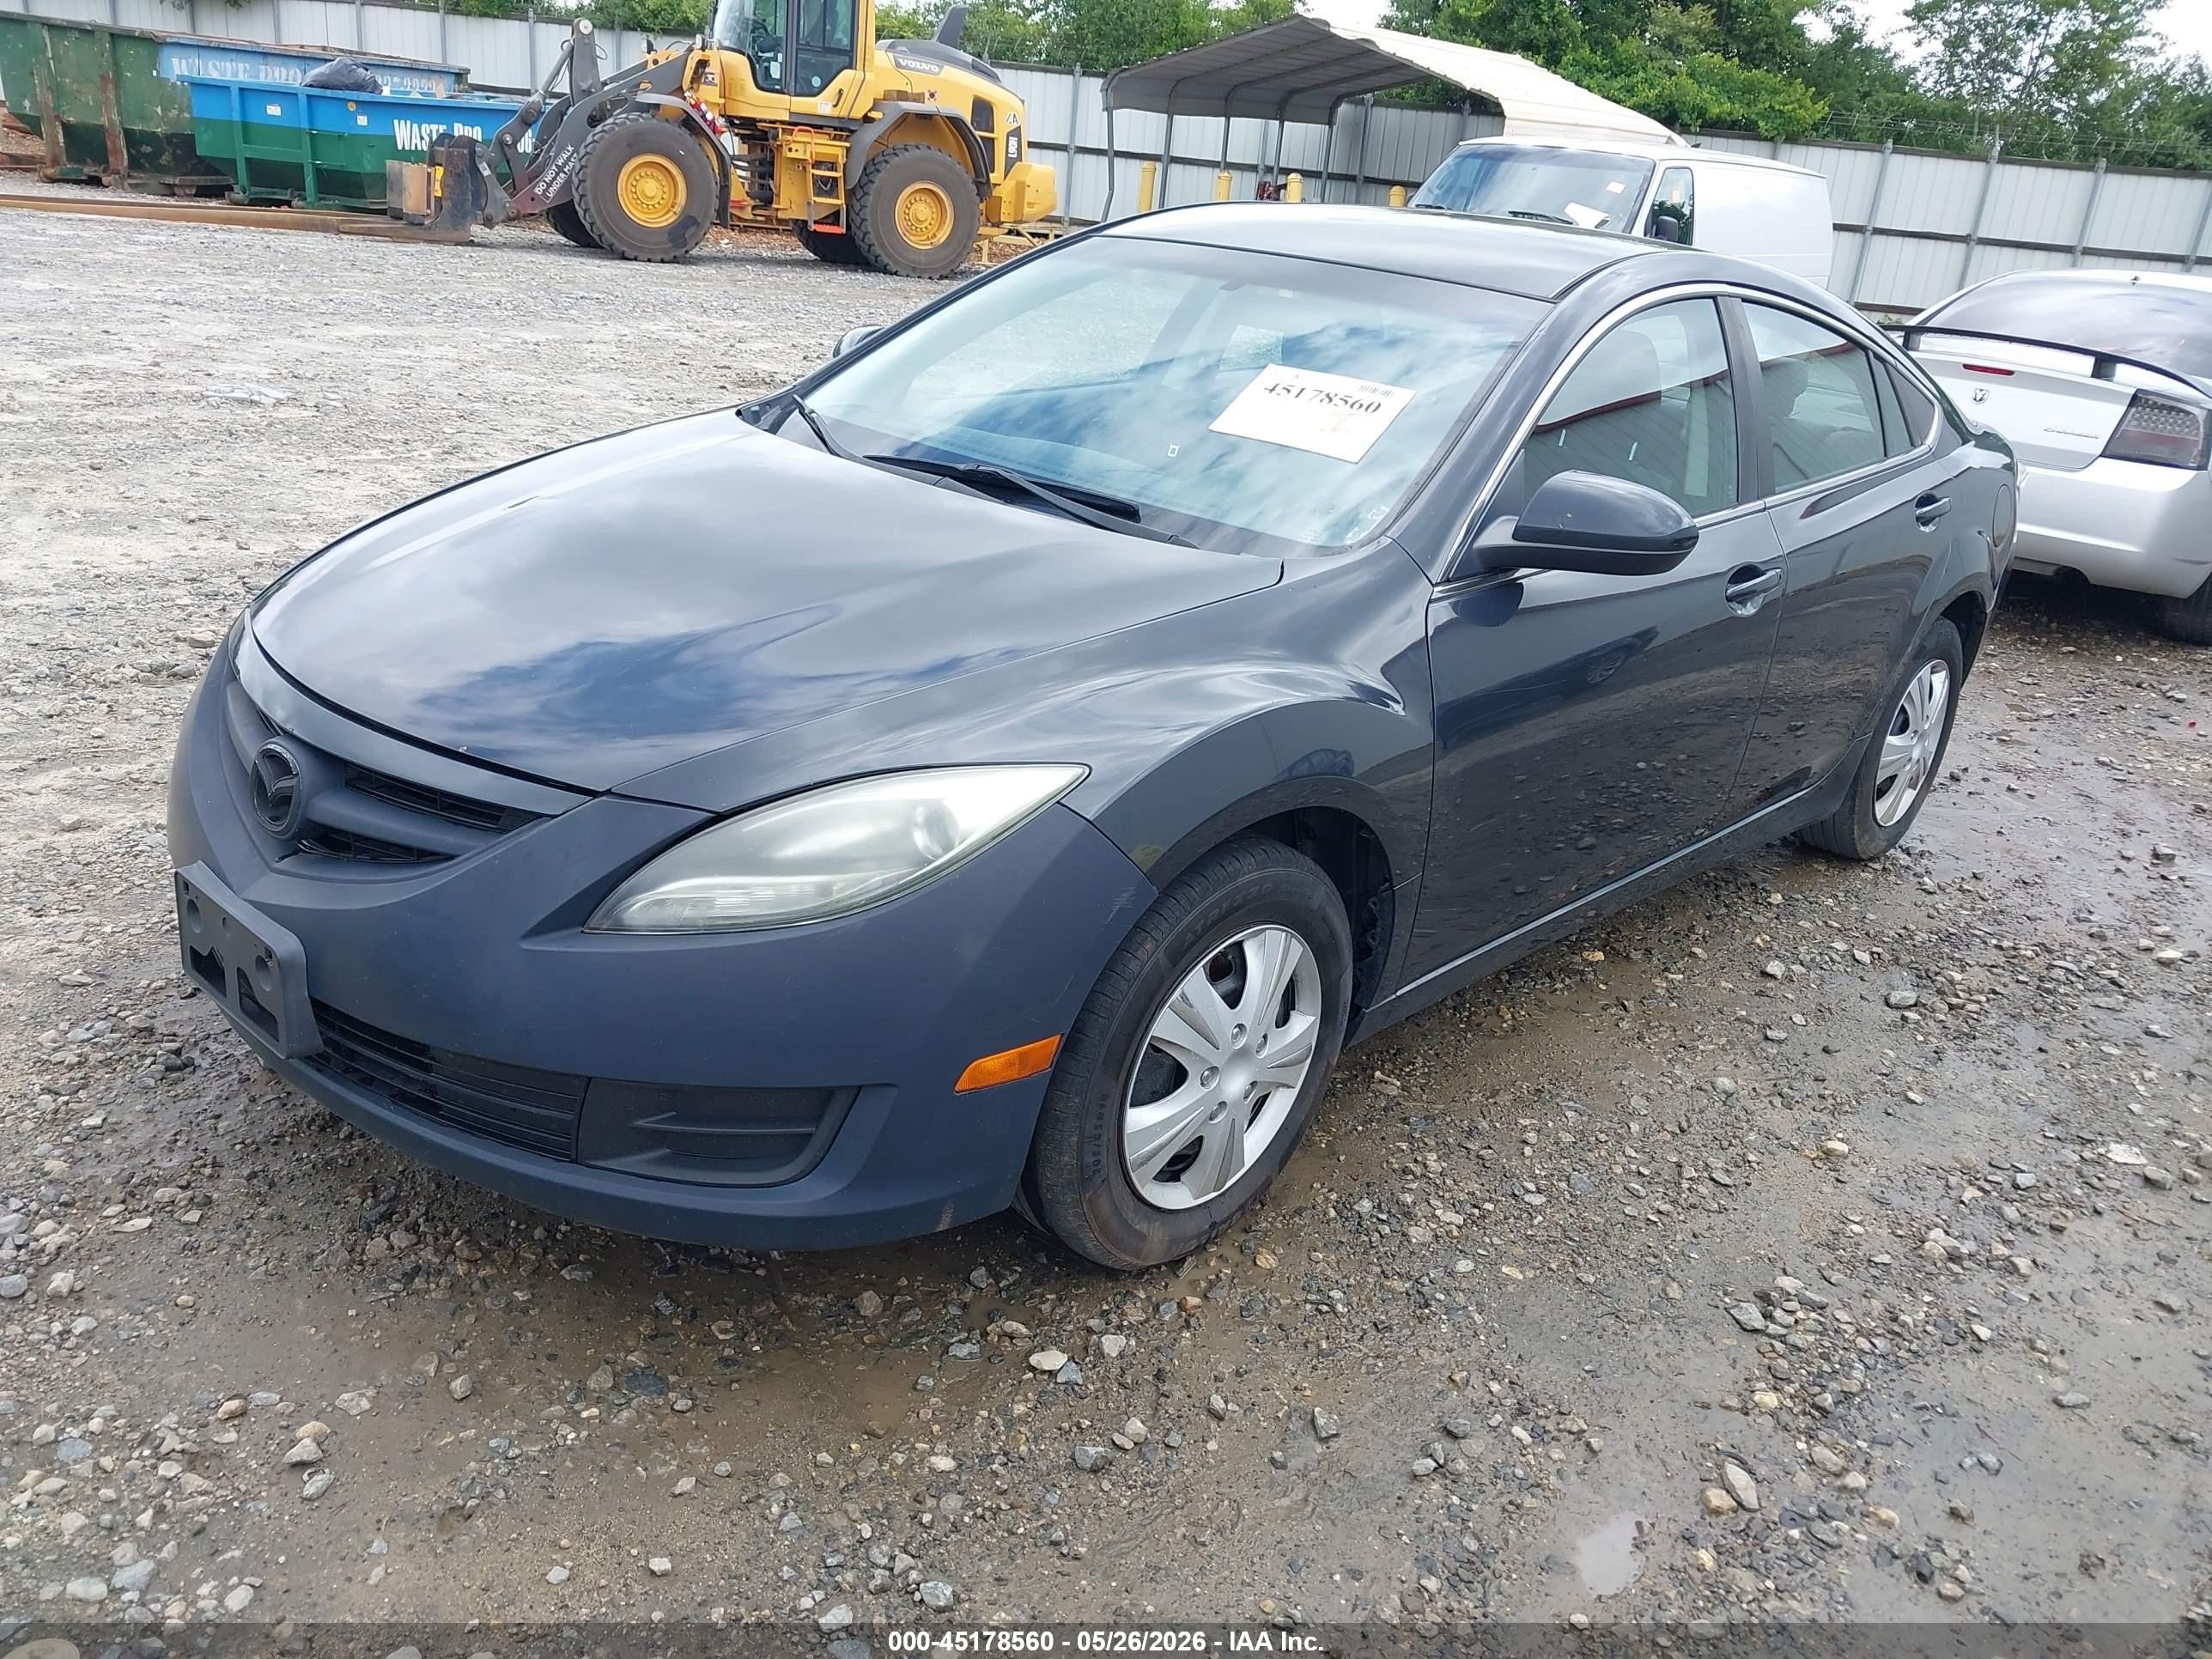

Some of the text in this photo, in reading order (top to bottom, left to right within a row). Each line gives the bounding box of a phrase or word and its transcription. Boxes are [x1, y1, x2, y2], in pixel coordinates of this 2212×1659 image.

[897, 58, 939, 73] VOLVO
[1007, 136, 1018, 158] L90H
[536, 143, 574, 195] DO NOT WALK
[545, 172, 567, 198] UNDER
[1264, 383, 1382, 413] 45178560
